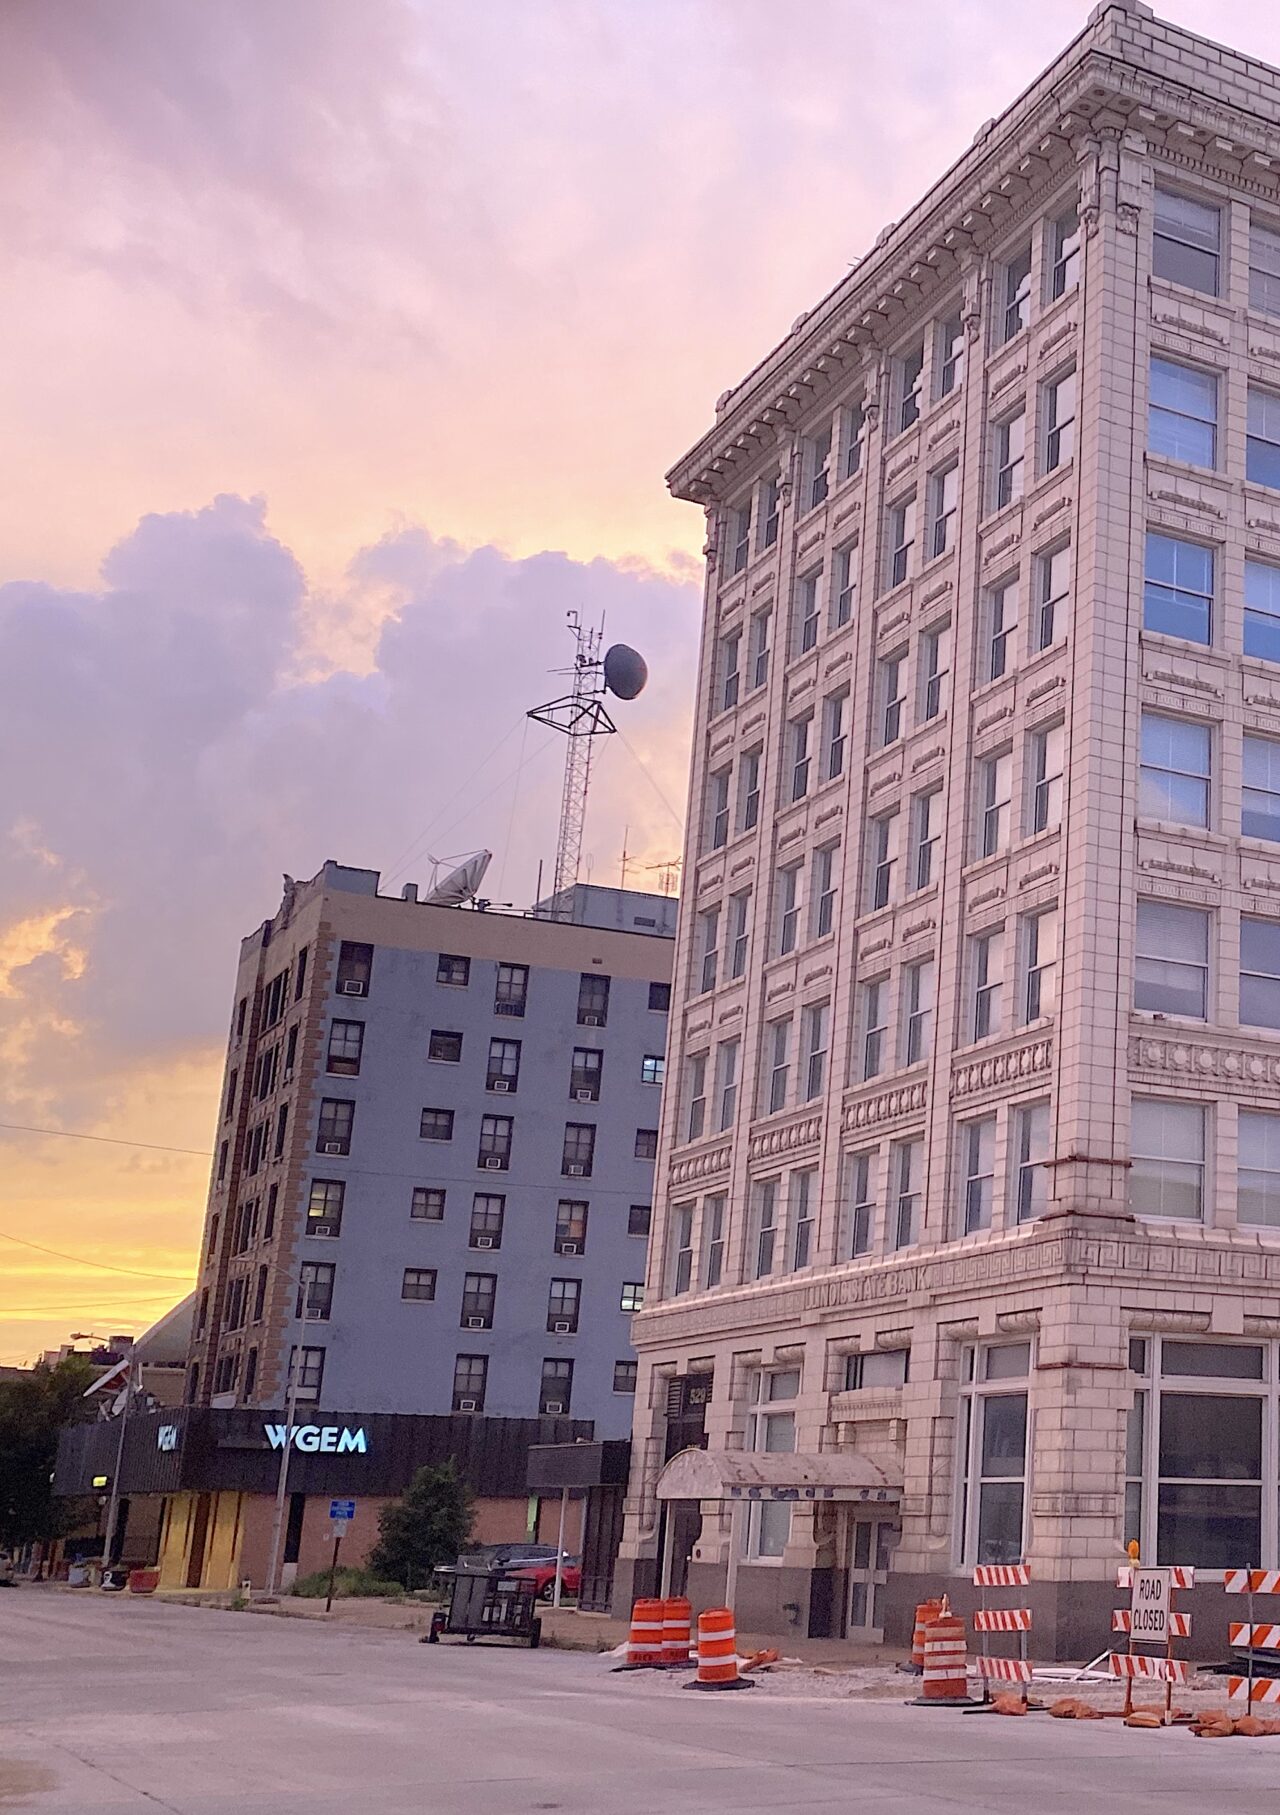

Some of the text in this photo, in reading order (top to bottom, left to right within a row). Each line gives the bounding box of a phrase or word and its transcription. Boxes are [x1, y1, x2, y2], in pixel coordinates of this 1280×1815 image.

[850, 1274, 886, 1301] STATE
[887, 1266, 929, 1296] BANK
[264, 1424, 367, 1453] WGEM
[1140, 1579, 1162, 1600] ROAD
[1134, 1609, 1165, 1631] CLOSED
